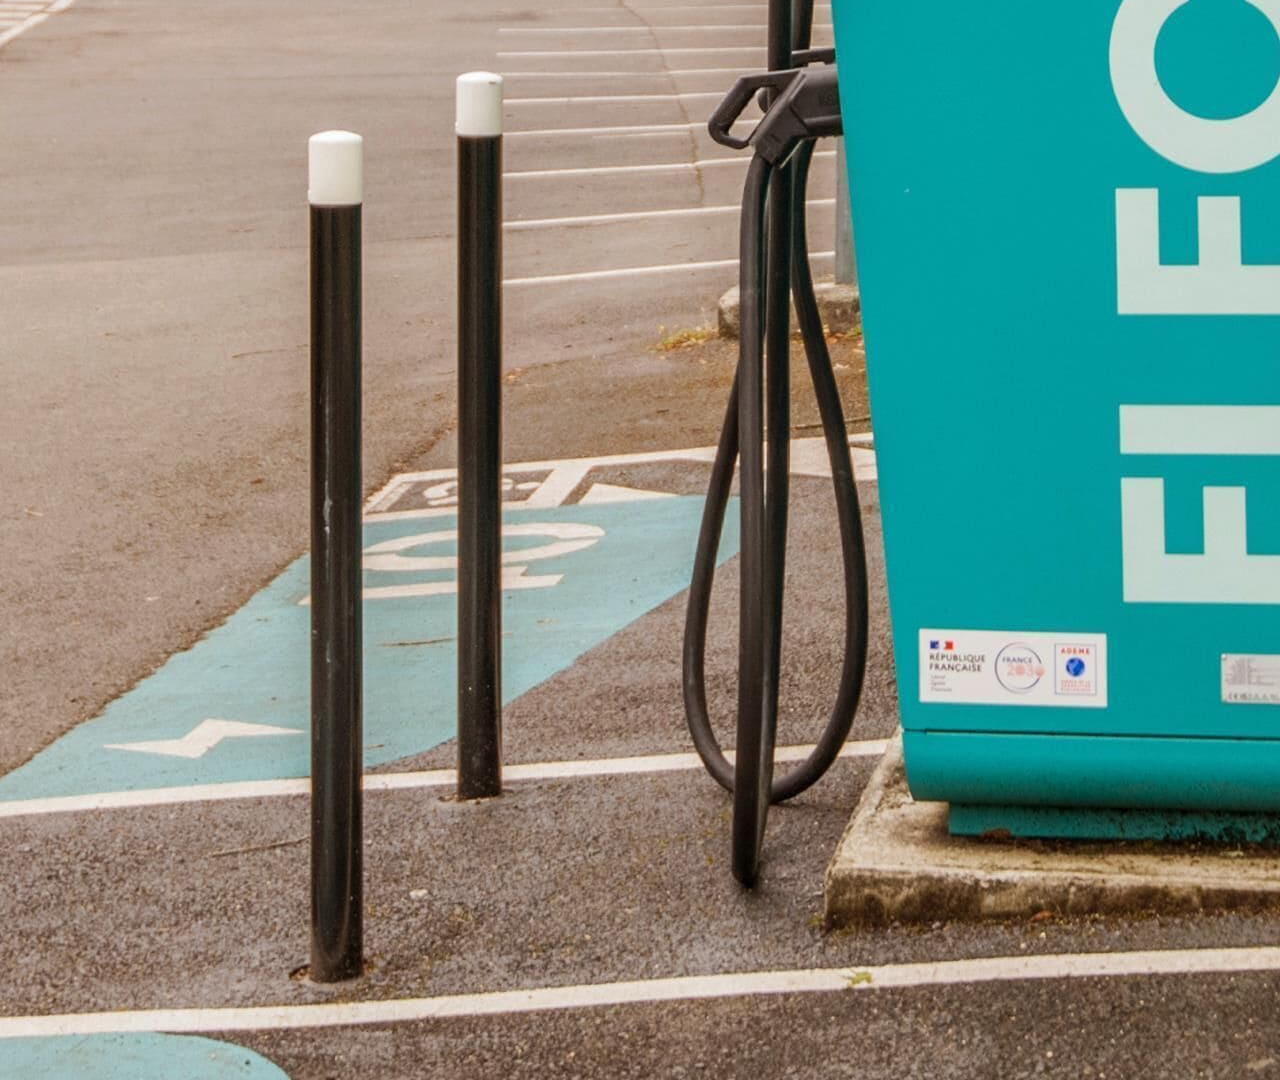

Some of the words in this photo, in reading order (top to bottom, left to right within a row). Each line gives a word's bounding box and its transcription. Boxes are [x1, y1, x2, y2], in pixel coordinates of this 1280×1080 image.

[1060, 647, 1090, 655] ADEME
[929, 652, 986, 663] RÉPUBLIQUE
[1002, 656, 1033, 664] FRANCE
[929, 662, 982, 672] FRANÇAISE
